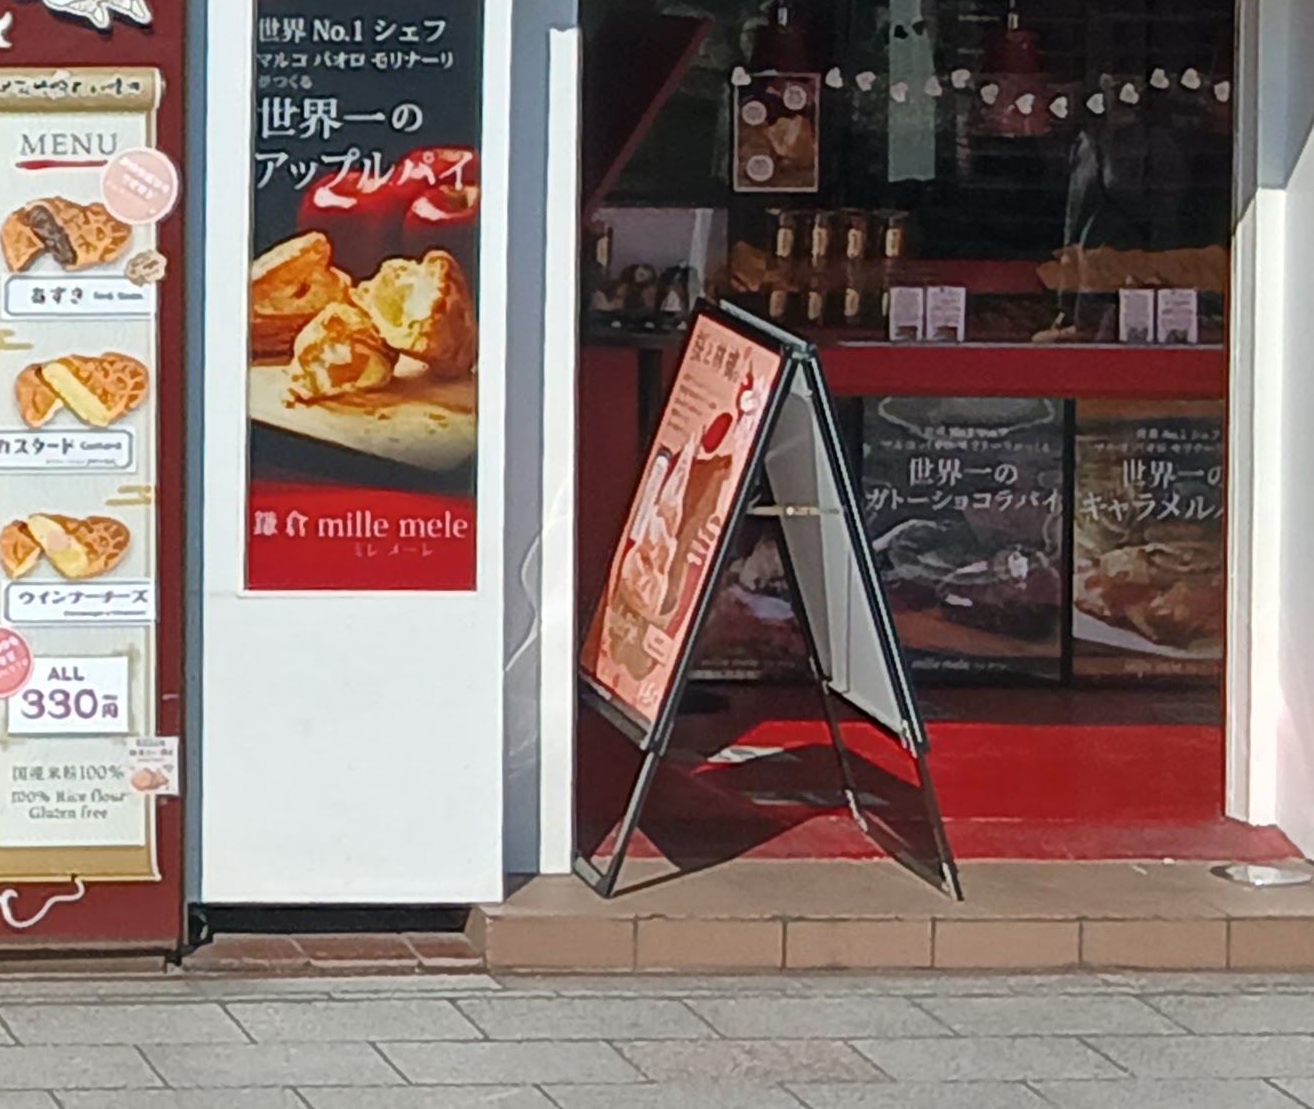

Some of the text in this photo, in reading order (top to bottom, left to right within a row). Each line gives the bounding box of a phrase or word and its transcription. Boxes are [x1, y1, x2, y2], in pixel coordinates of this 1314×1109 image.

[259, 17, 447, 43] 世界 No.1 シェフ
[257, 96, 424, 140] 世界一の
[19, 132, 119, 157] MENU
[254, 147, 474, 191] アップルパイ
[31, 286, 84, 305] あずき
[909, 456, 1018, 486] 世界一の
[1080, 492, 1224, 522] キャラメル
[318, 510, 389, 538] mille
[399, 510, 469, 538] mele
[47, 666, 85, 682] ALL
[20, 688, 119, 720] 330円
[80, 804, 109, 820] free
